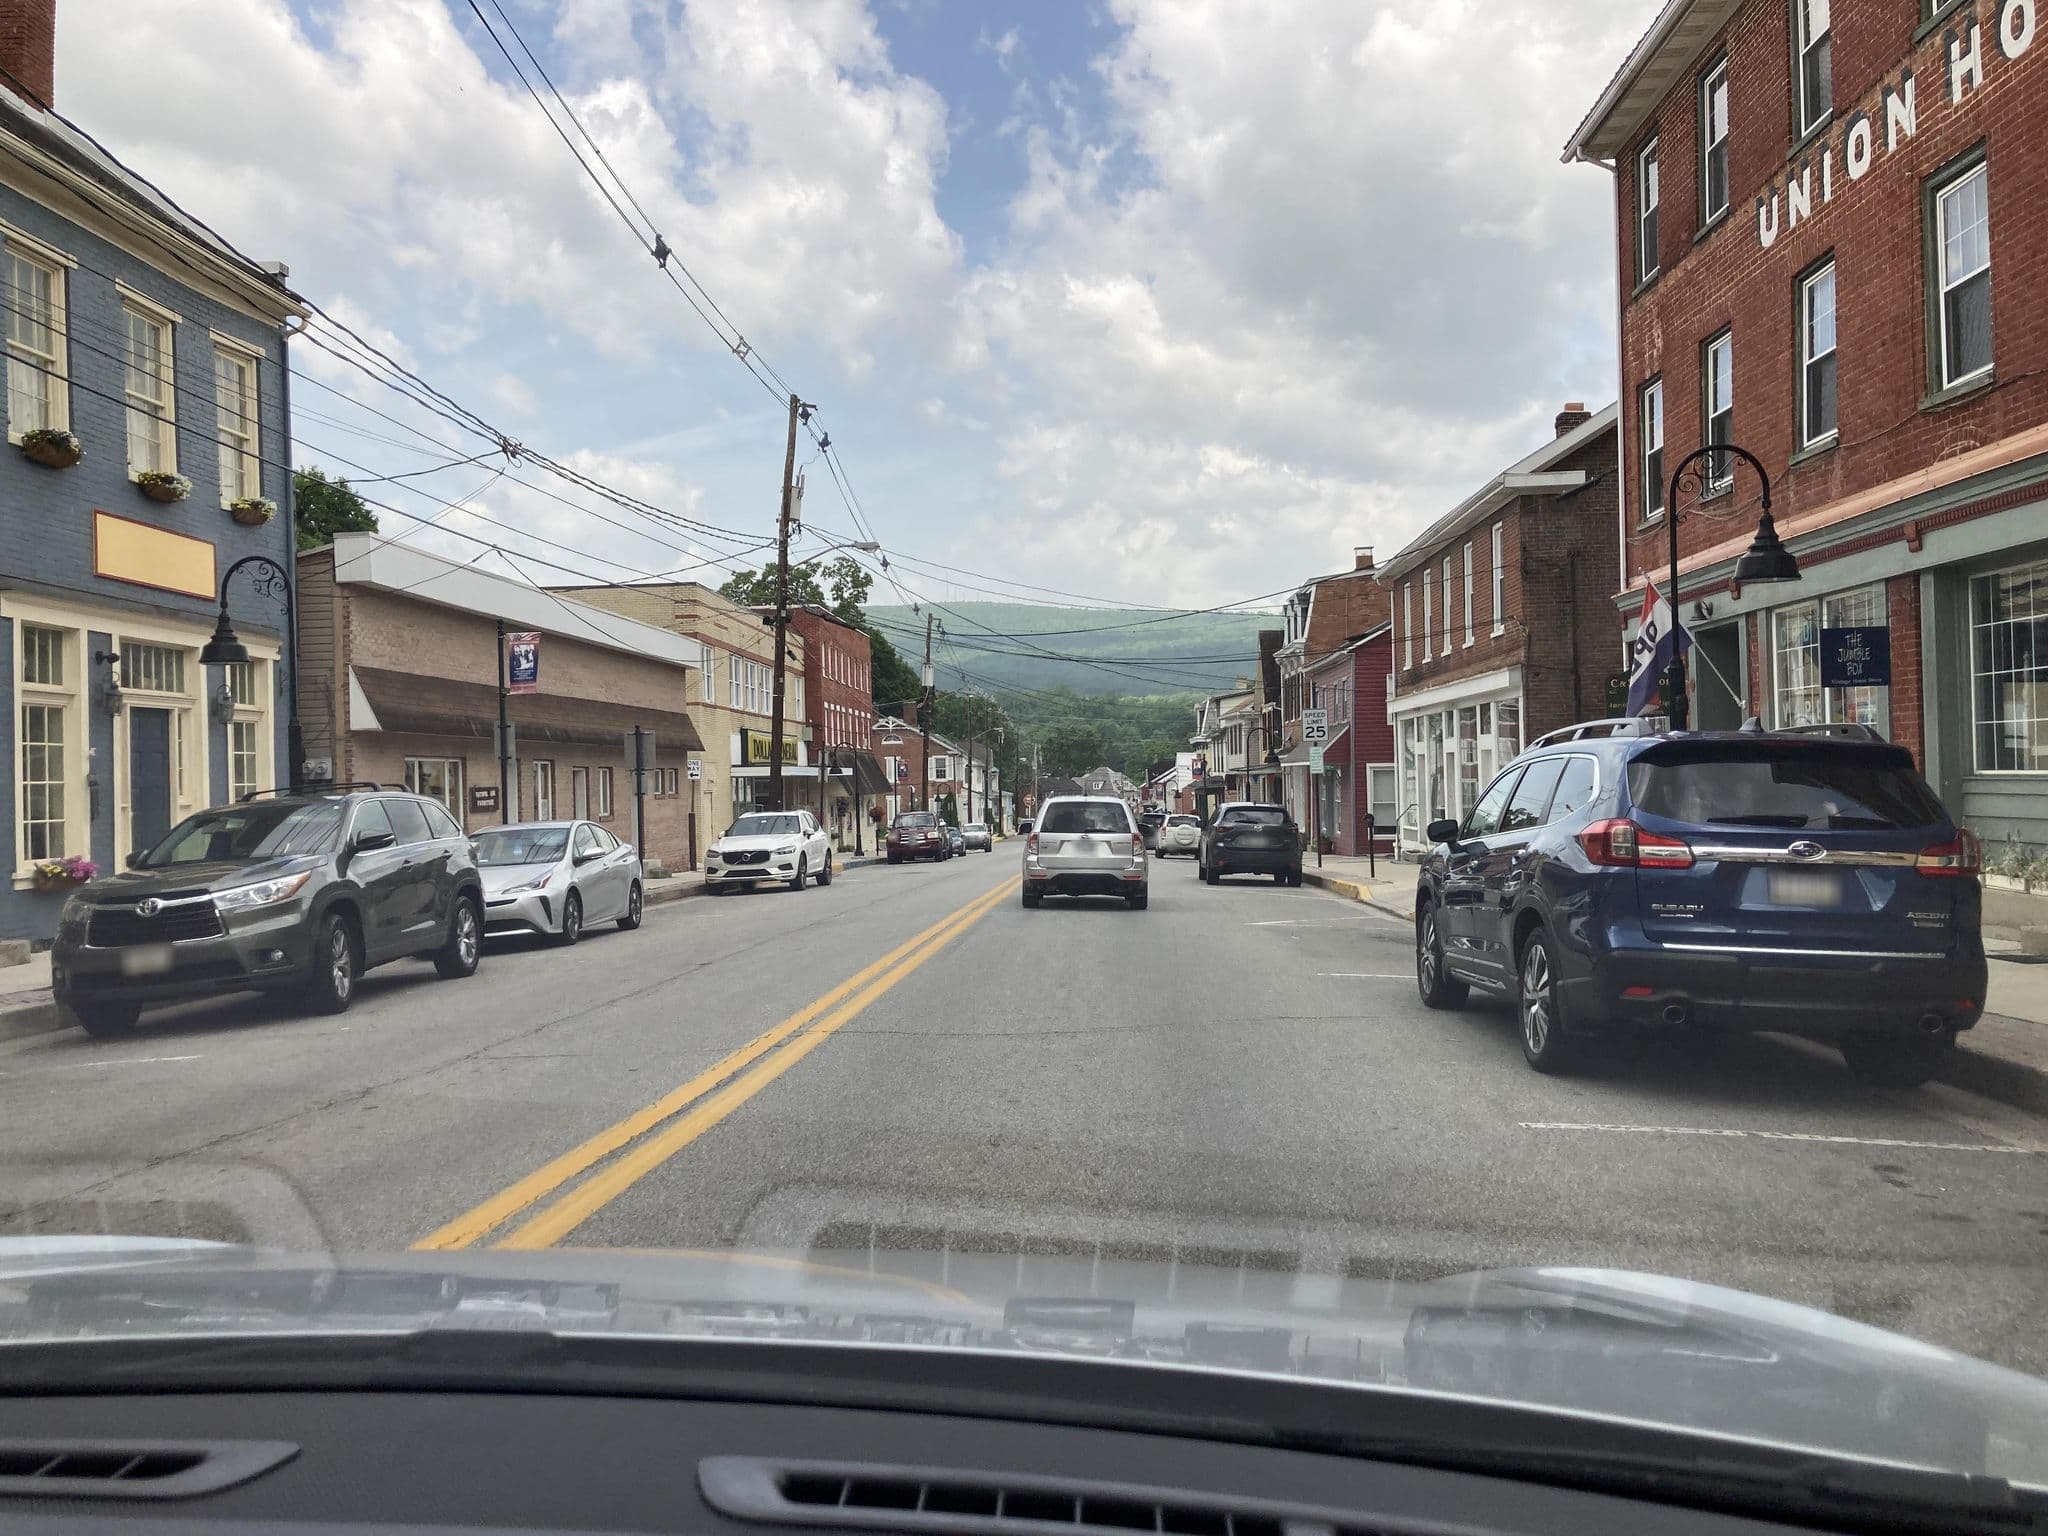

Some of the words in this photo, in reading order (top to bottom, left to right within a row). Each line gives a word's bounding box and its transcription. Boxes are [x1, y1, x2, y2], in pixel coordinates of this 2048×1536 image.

[1758, 73, 1917, 248] UNION
[1845, 630, 1862, 648] THE
[1846, 661, 1863, 676] BOX
[1305, 726, 1326, 738] 25
[1651, 903, 1704, 911] SUBARU
[1905, 911, 1952, 919] ASCENT
